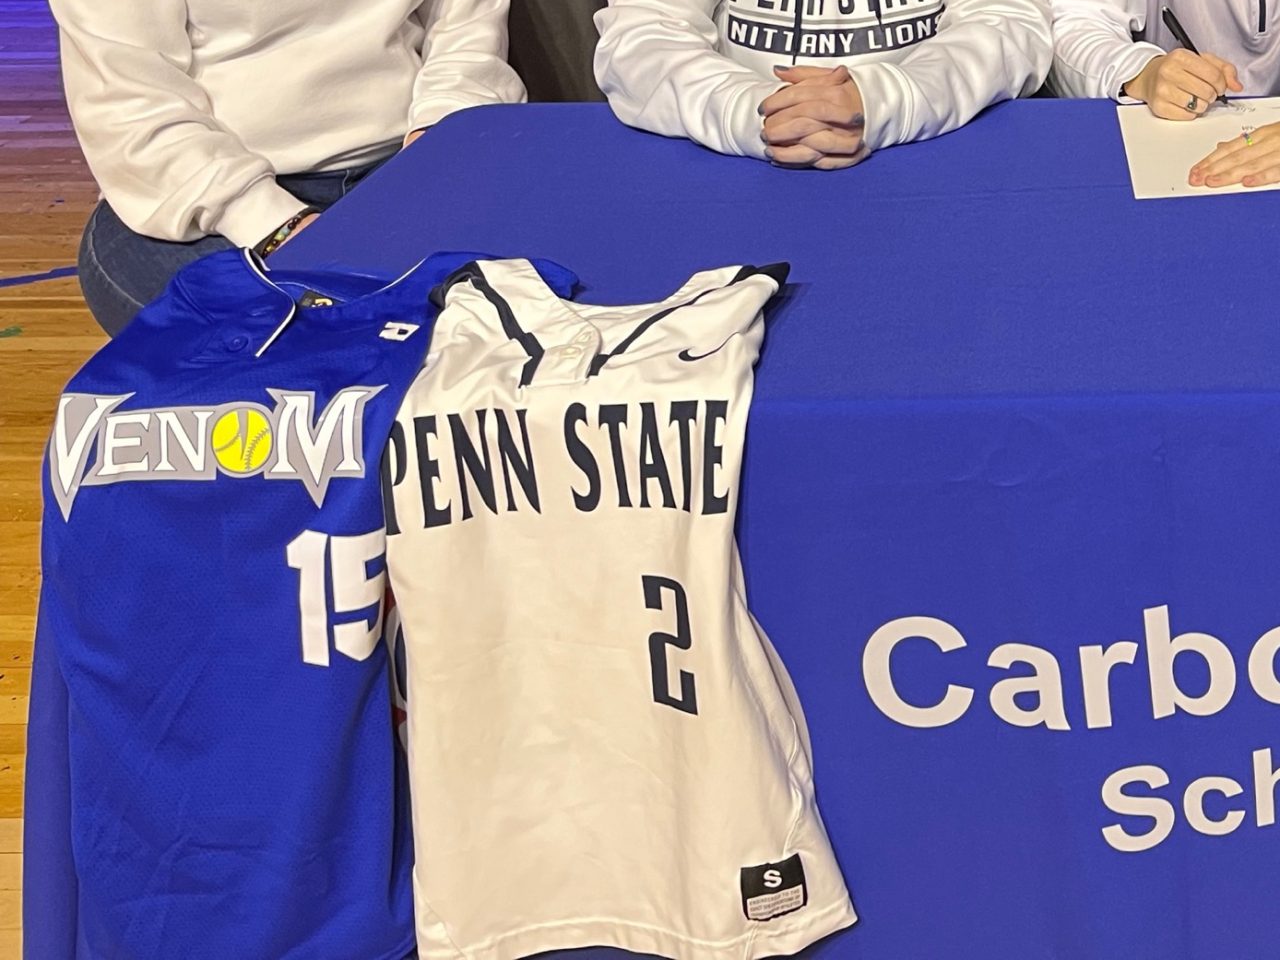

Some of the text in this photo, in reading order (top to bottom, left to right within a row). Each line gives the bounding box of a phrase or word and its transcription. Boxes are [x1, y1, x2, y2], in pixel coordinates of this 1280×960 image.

[730, 19, 854, 54] NITTANY
[49, 383, 390, 524] VENOM
[380, 399, 730, 536] PENN STATE
[286, 529, 387, 667] 15
[641, 574, 699, 716] 2
[763, 869, 782, 888] S
